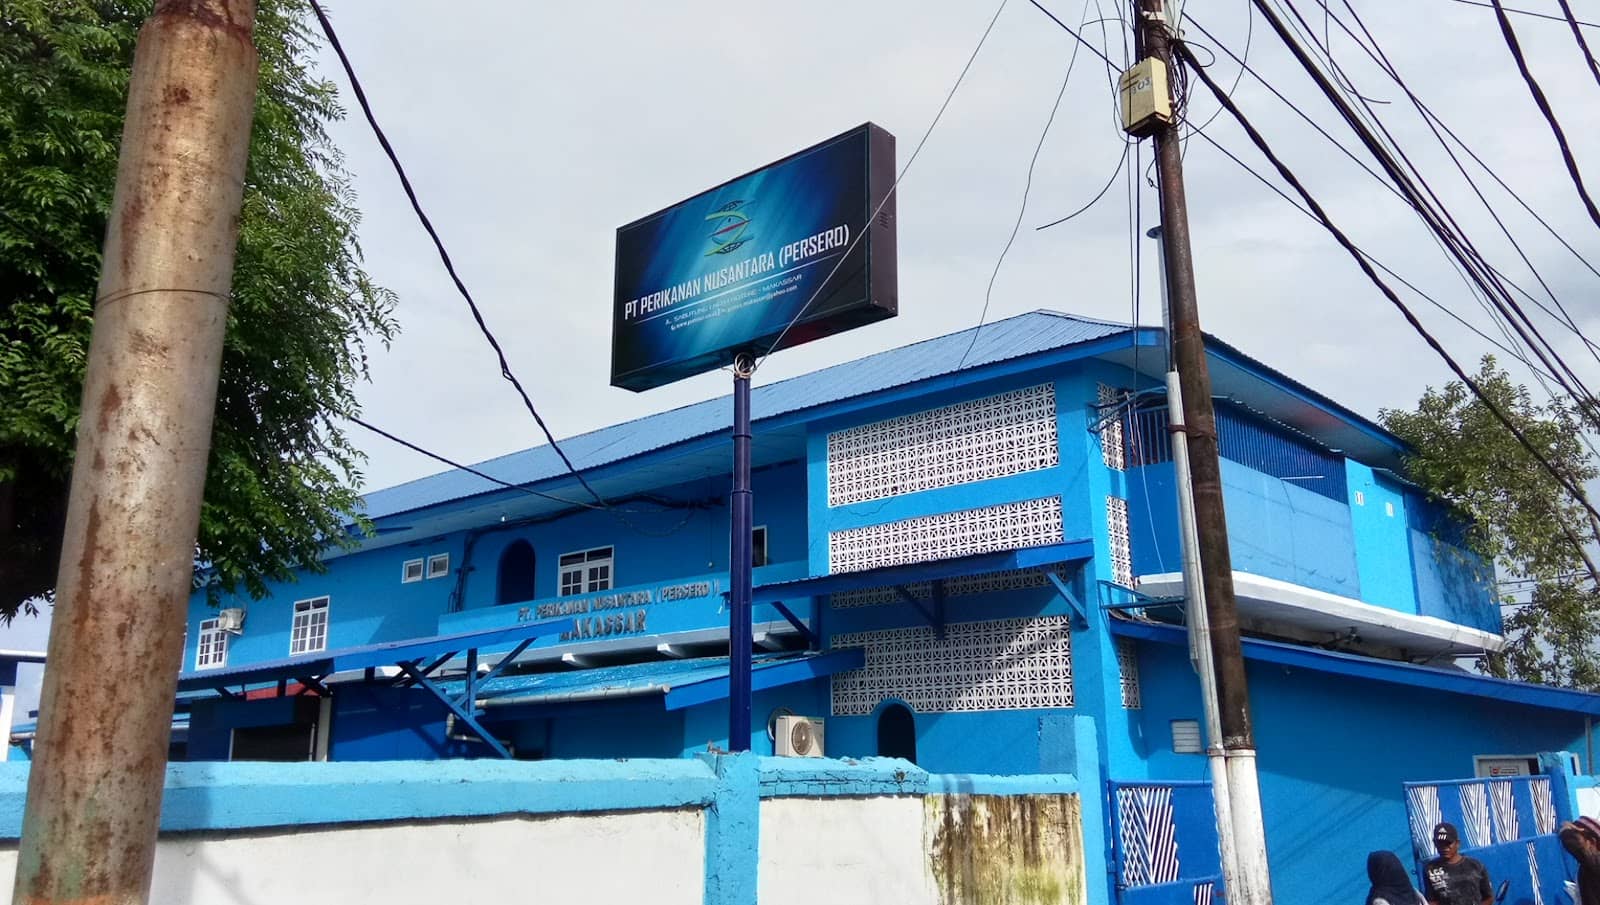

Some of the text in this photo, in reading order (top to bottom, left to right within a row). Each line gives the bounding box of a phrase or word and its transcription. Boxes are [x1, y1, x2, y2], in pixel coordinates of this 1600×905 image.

[624, 299, 639, 320] PT
[640, 277, 701, 315] PERIKANAN
[703, 251, 775, 293] NUSANTARA
[778, 224, 850, 268] (PERSERO)
[536, 599, 590, 620] PERIKANAN
[593, 590, 652, 611] NUSANTARA
[560, 610, 646, 640] AKASSAR
